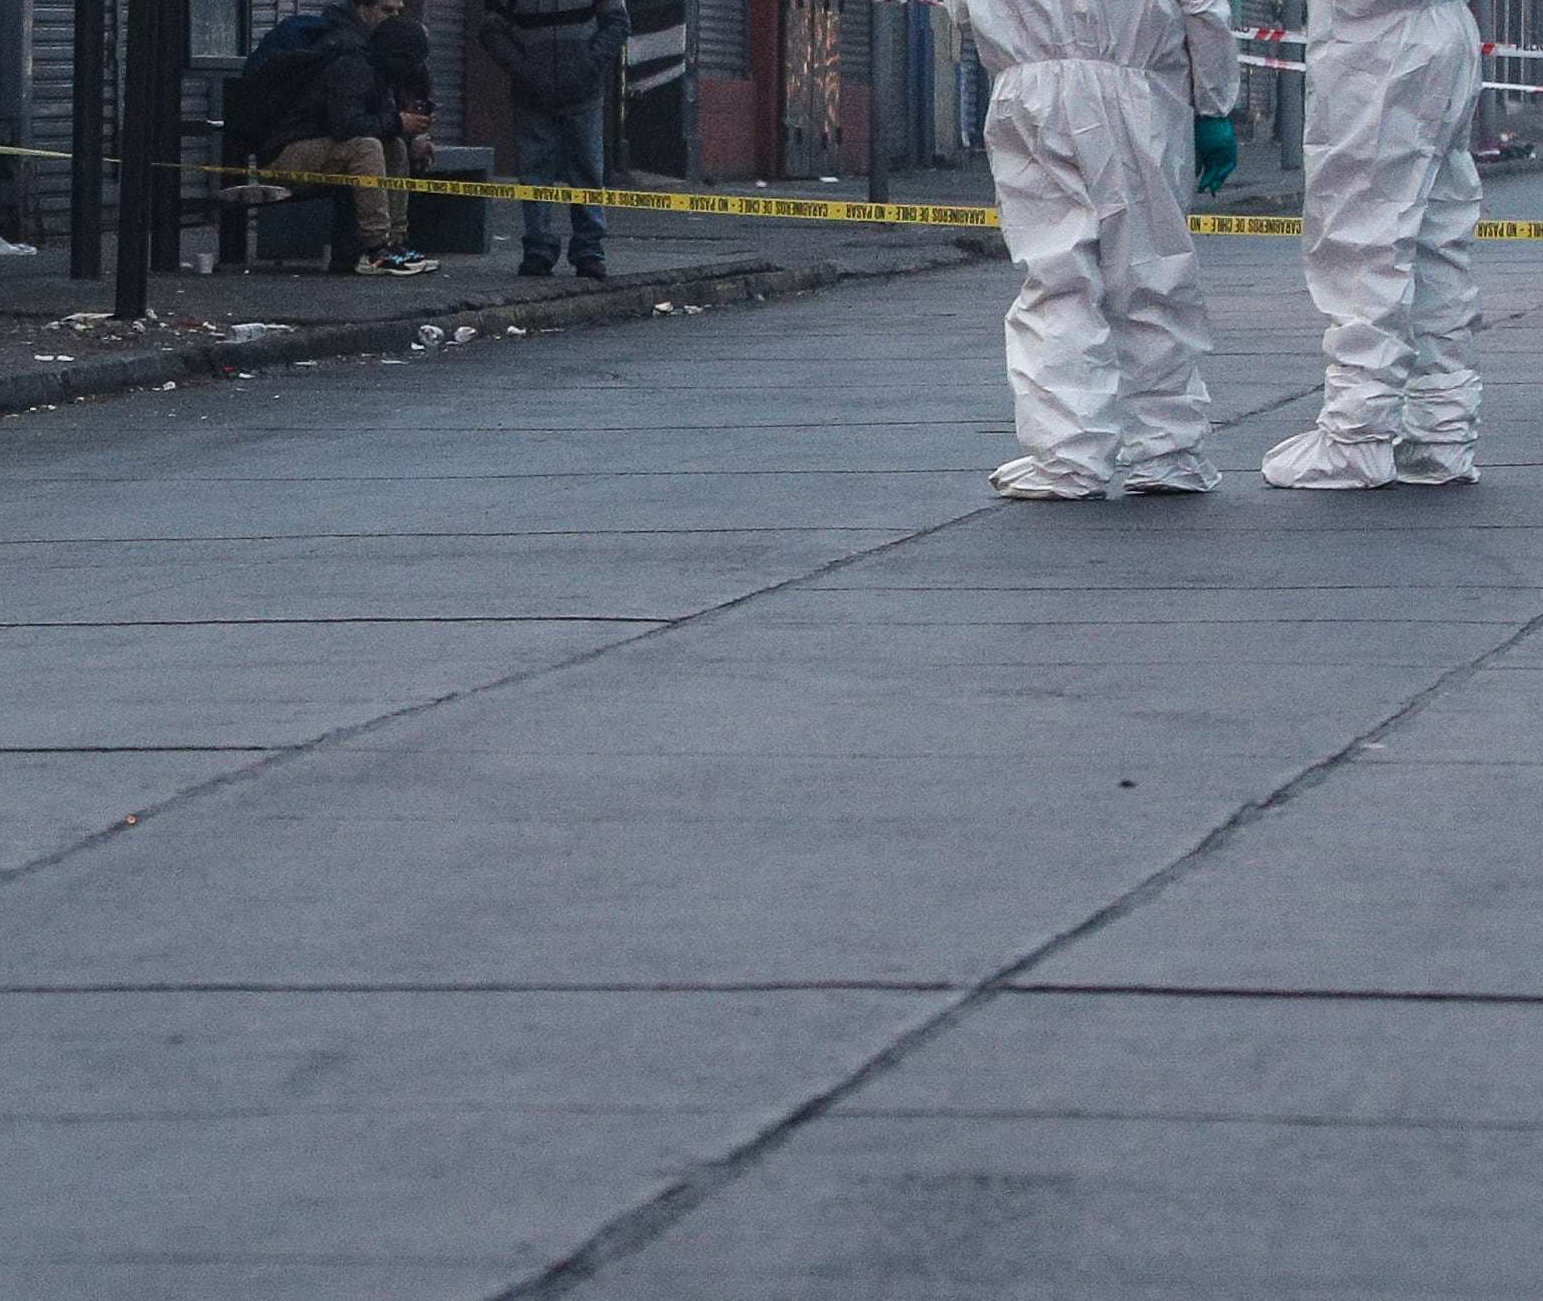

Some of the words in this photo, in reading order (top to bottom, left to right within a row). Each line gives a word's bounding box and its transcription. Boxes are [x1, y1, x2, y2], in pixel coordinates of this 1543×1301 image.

[689, 196, 716, 211] PASAR
[717, 198, 729, 212] NO
[738, 198, 761, 214] CHILE
[762, 200, 774, 215] DE
[776, 200, 829, 218] CARABINEROS
[846, 203, 873, 219] PASAR
[874, 204, 886, 220] NO
[895, 205, 919, 222] CHILE
[919, 207, 930, 222] DE
[932, 206, 986, 226] CARABINEROS
[1235, 218, 1245, 233] DE
[1248, 218, 1302, 234] CARABINEROS
[1477, 222, 1504, 237] PASAR
[1506, 222, 1517, 237] NO
